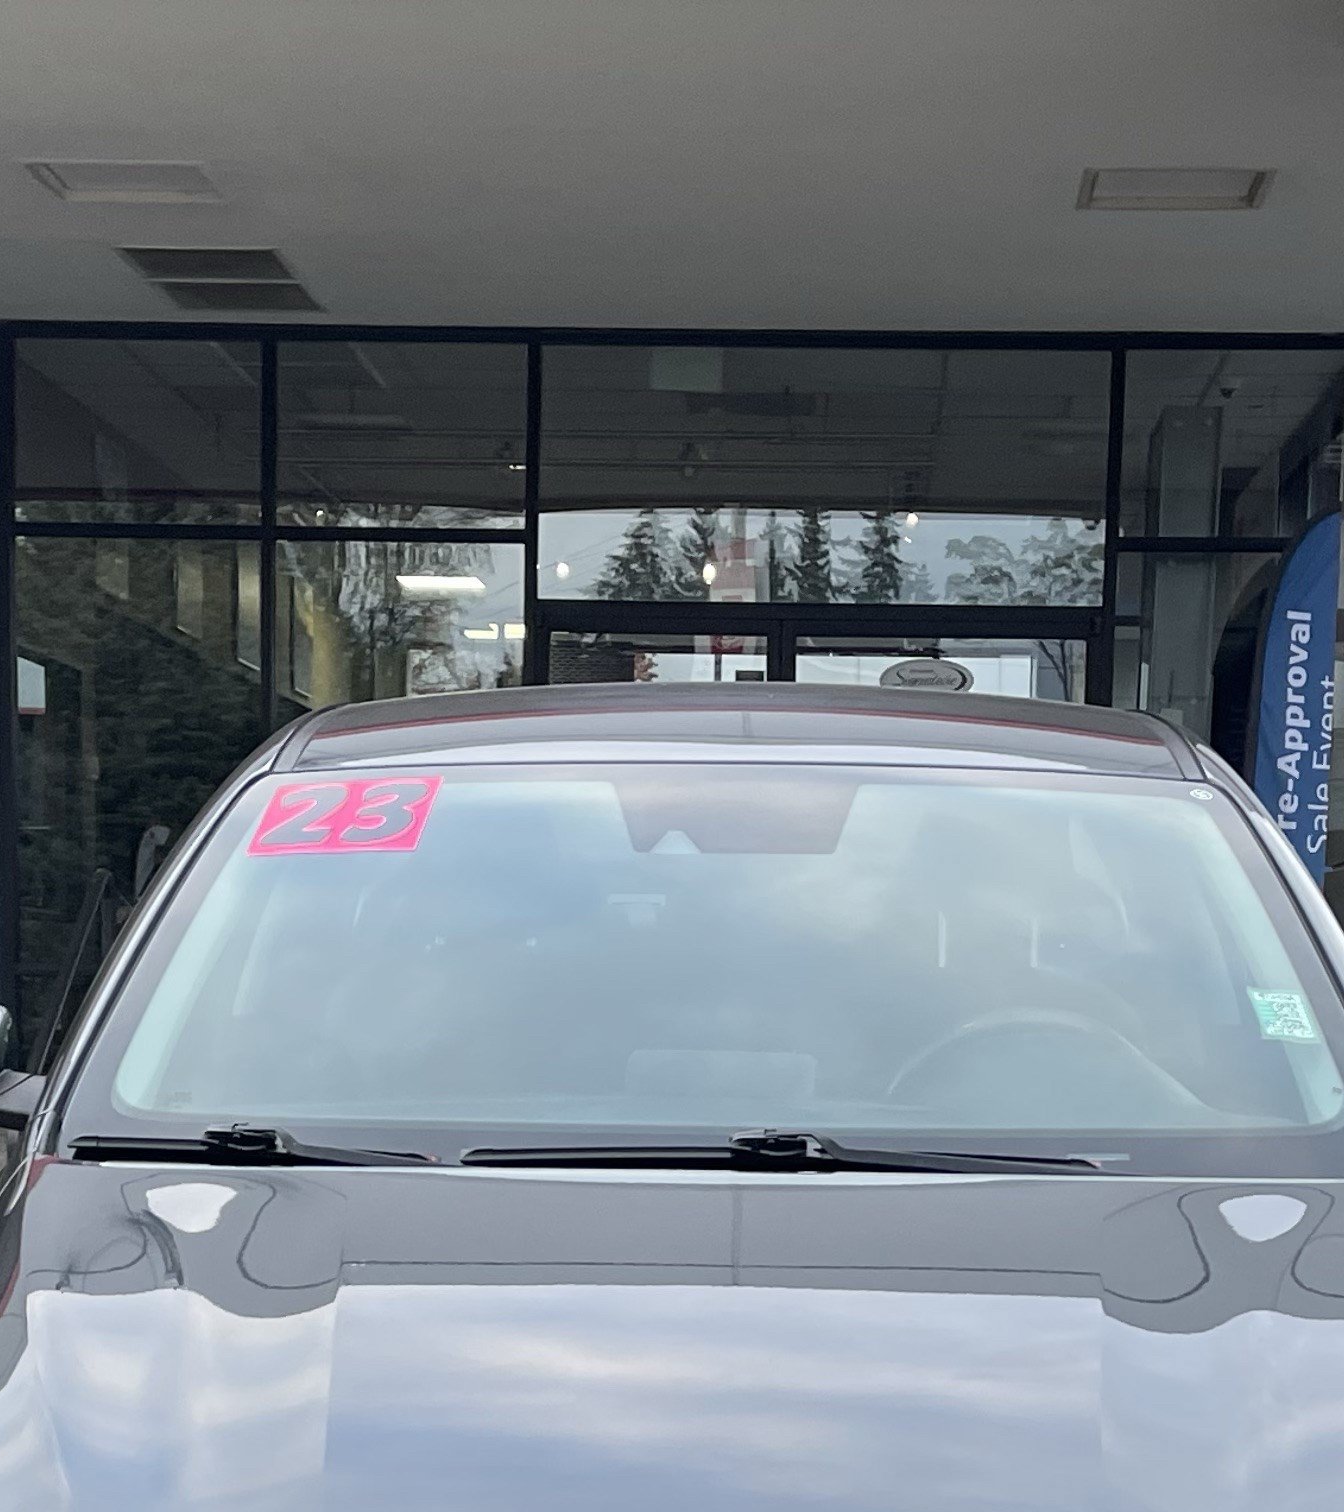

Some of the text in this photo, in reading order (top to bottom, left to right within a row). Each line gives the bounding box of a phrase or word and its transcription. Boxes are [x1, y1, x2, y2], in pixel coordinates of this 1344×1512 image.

[1276, 610, 1312, 830] re-Approval
[1306, 674, 1335, 853] Sale Event
[259, 782, 431, 847] 23
